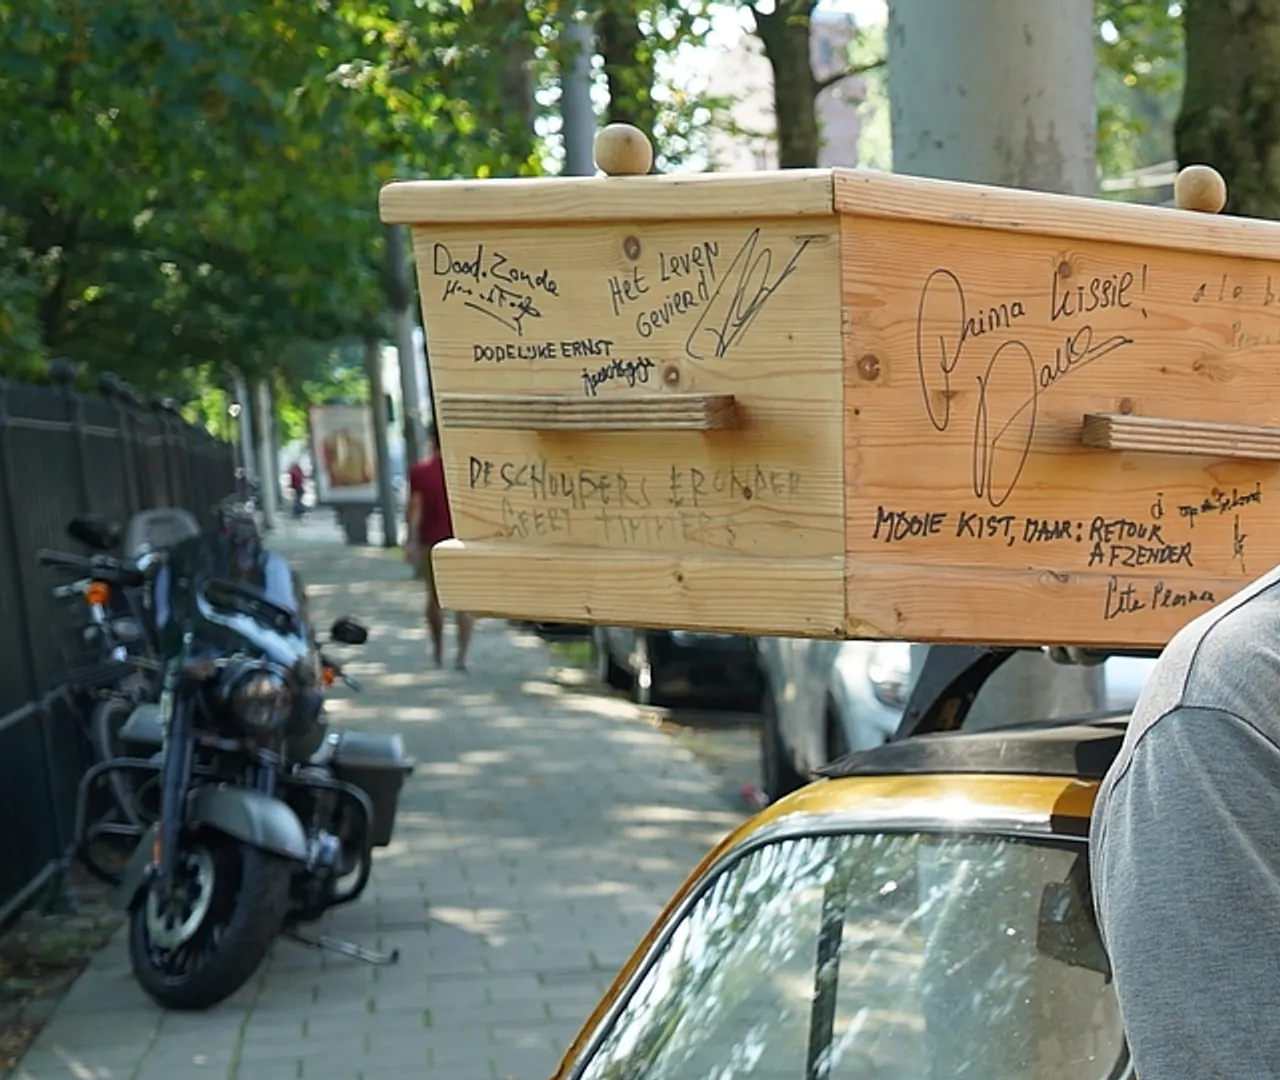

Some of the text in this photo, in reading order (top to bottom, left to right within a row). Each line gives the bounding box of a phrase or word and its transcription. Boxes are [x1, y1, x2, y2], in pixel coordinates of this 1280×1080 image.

[608, 266, 649, 316] Het
[560, 338, 614, 358] ERNST
[1089, 516, 1165, 545] RETOUR
